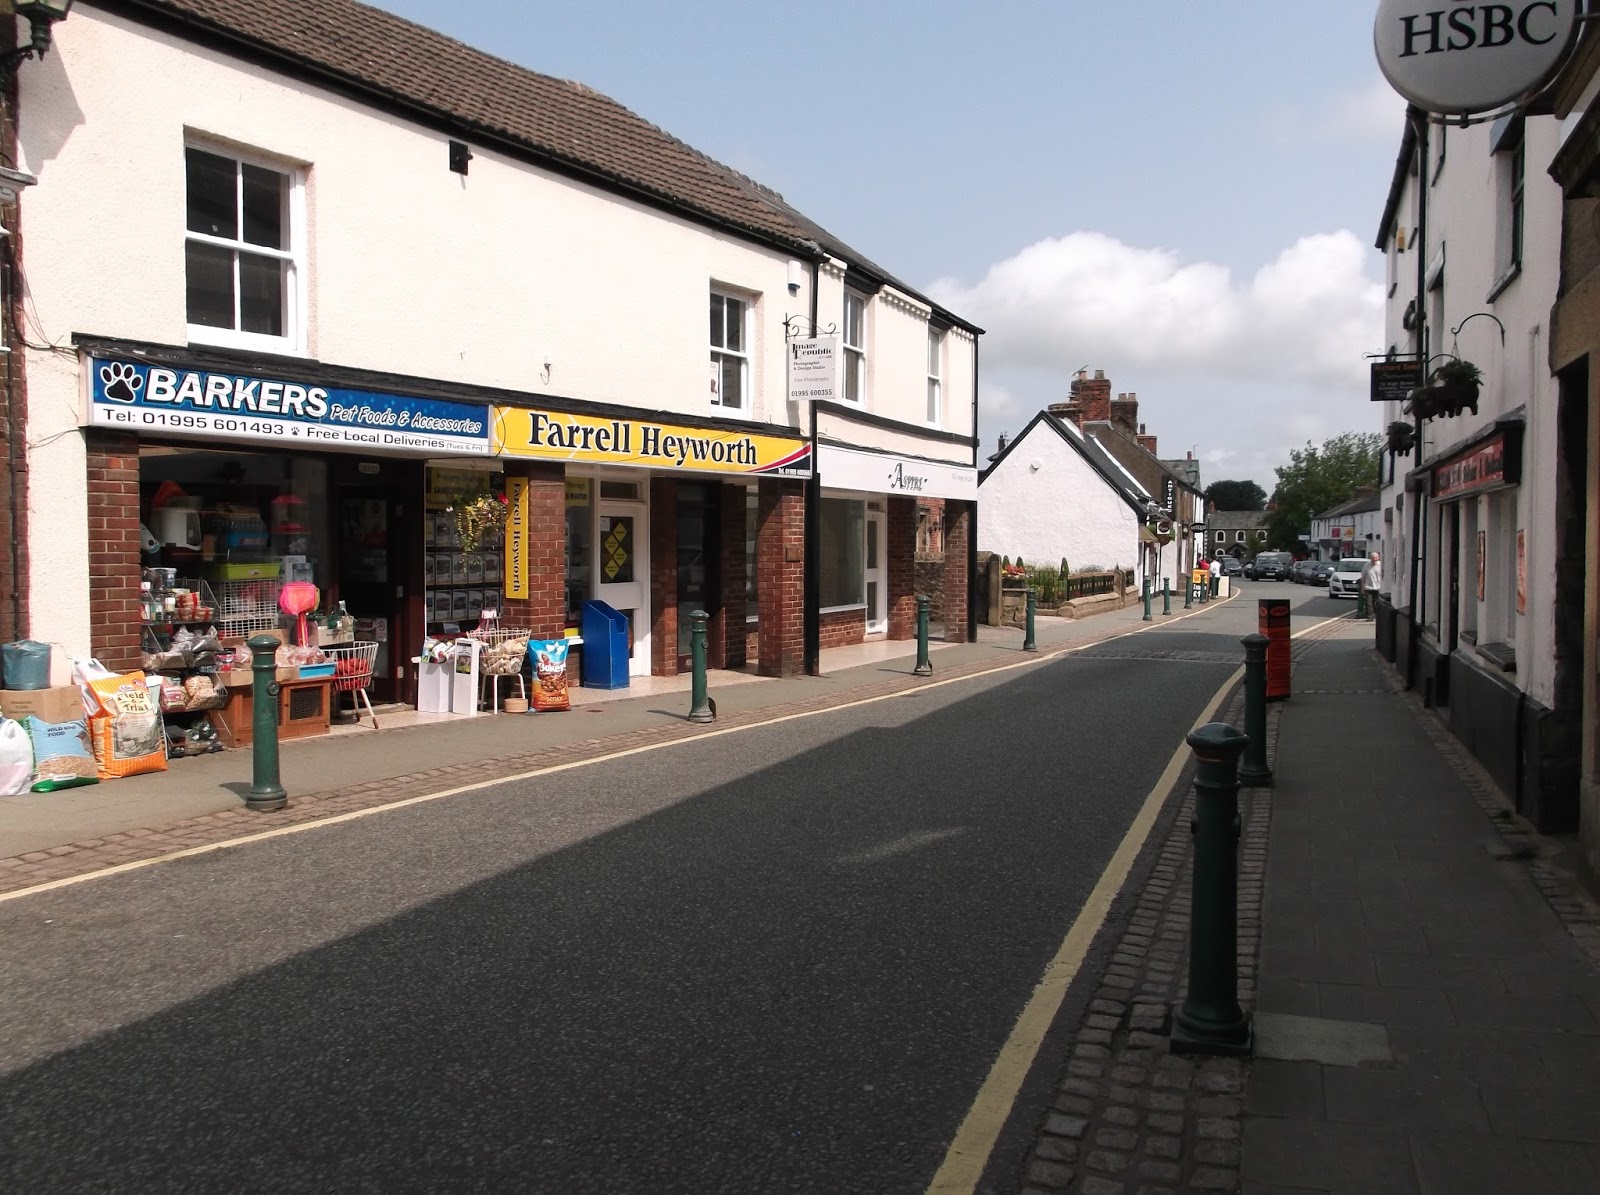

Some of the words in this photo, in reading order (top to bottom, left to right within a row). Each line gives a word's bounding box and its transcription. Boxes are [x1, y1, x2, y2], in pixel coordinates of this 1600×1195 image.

[1398, 1, 1557, 57] HSBC
[792, 343, 818, 353] Image
[794, 348, 833, 360] Republic
[145, 368, 328, 417] BARKERS
[103, 408, 136, 422] Tel:
[142, 412, 208, 429] 01995
[213, 419, 284, 435] 601493
[330, 403, 356, 420] Pet
[358, 406, 397, 424] Foods
[398, 411, 410, 426] &
[411, 411, 482, 433] Accessories
[306, 427, 340, 440] Free
[343, 431, 380, 443] Local
[384, 433, 445, 448] Deliveries
[528, 412, 631, 453] Farrell
[640, 426, 758, 467] Heyworth
[513, 483, 521, 525] Farrell
[512, 531, 521, 592] Heyworth
[123, 704, 149, 712] Trial
